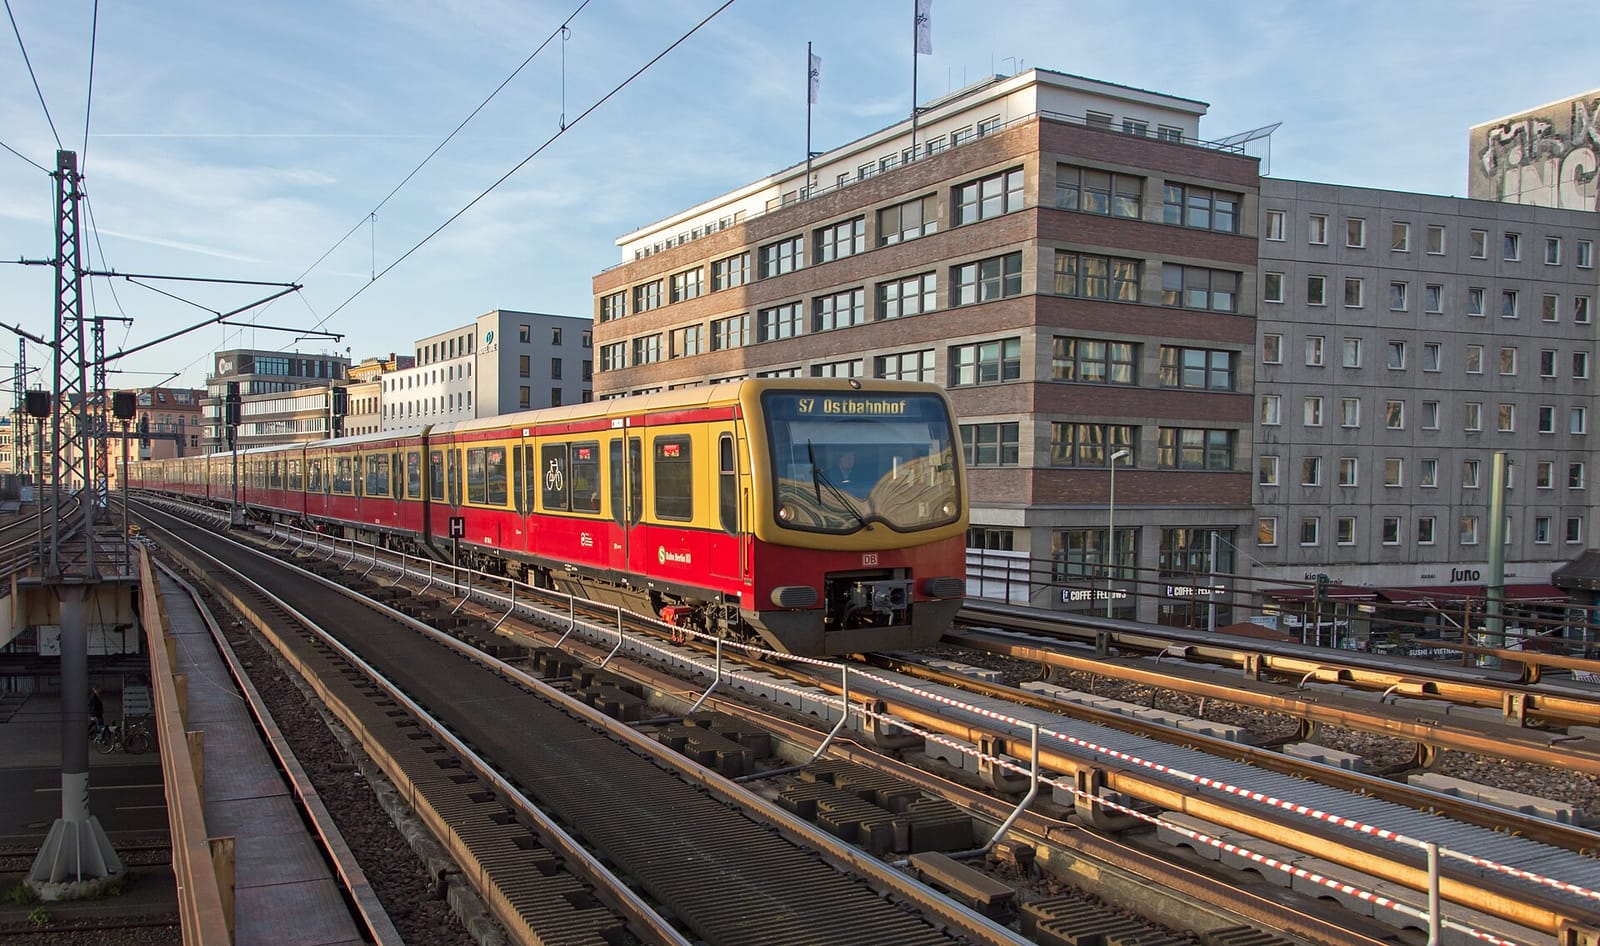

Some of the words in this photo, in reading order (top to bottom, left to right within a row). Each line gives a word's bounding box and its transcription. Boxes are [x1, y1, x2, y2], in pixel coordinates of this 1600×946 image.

[799, 398, 815, 413] S7
[823, 399, 906, 414] Ostbahnhof
[451, 519, 463, 535] H
[863, 554, 878, 565] DB
